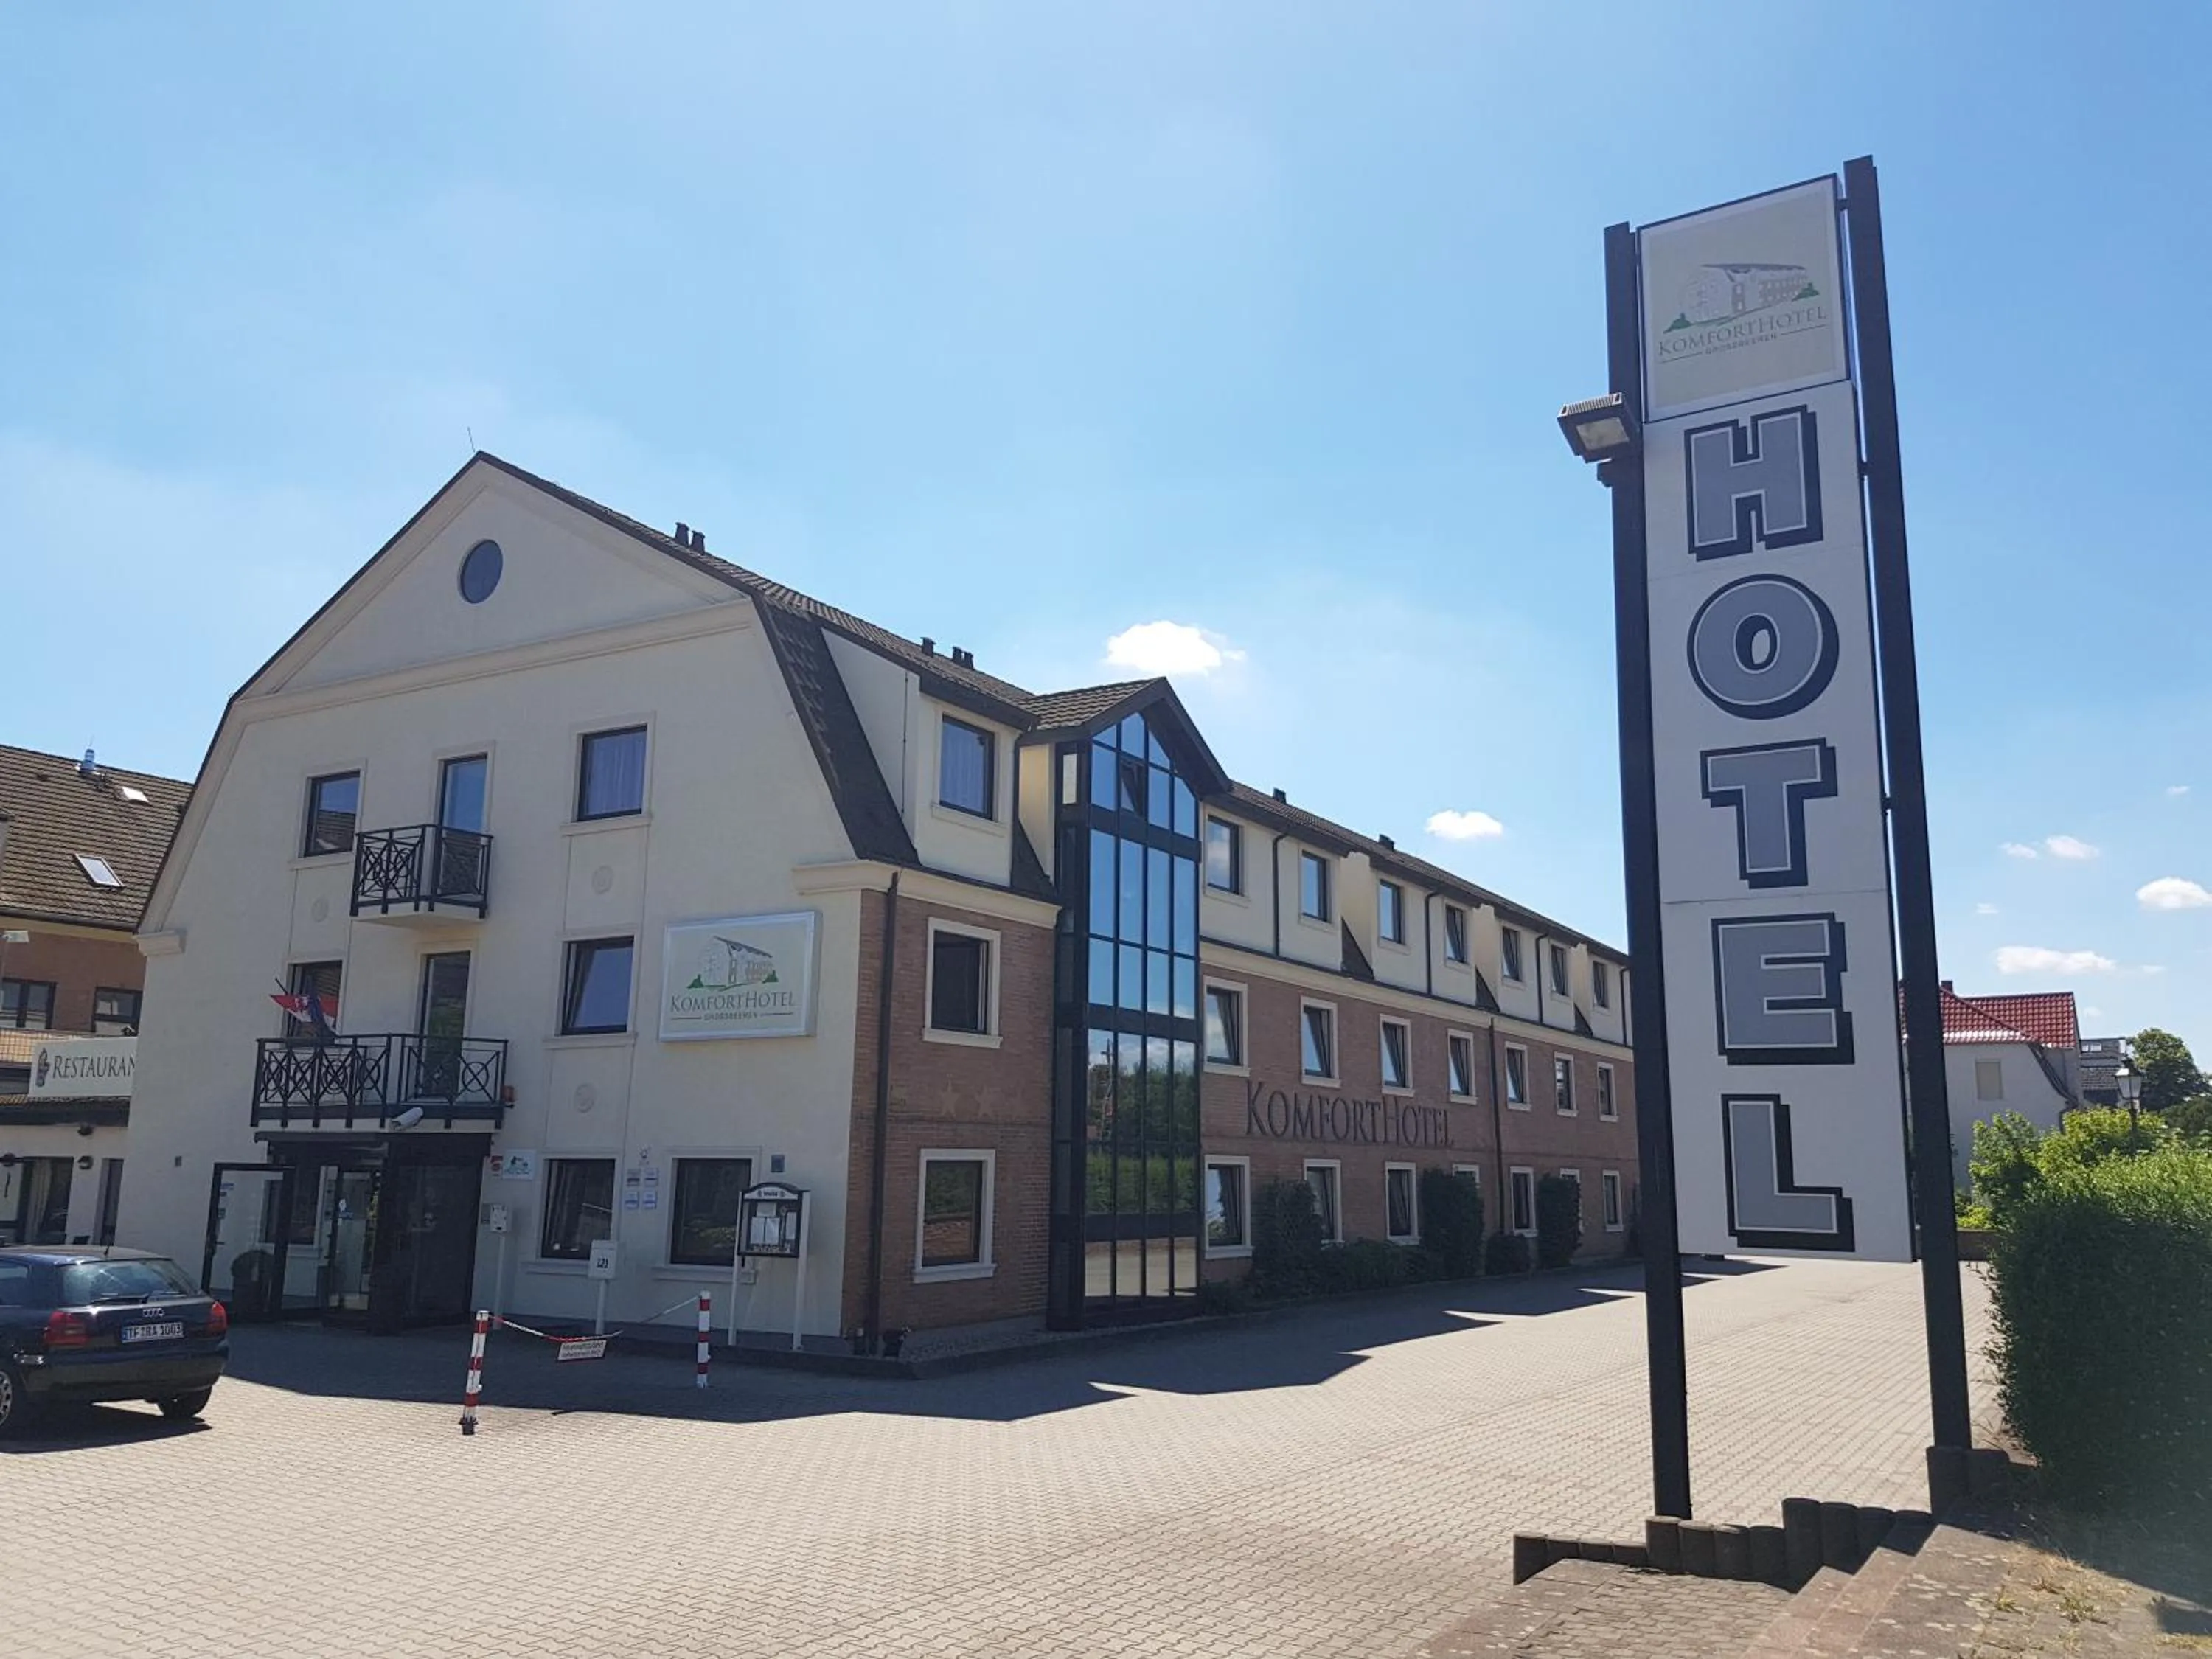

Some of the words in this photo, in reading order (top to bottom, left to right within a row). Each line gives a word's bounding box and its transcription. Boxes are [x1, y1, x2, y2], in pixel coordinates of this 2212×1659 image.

[1658, 306, 1827, 356] KOMFORTHOTEL
[1683, 404, 1855, 1253] HOTEL
[670, 990, 795, 1012] KOMFORTHOTEL
[1245, 1079, 1454, 1147] KOMFORTHOTEL
